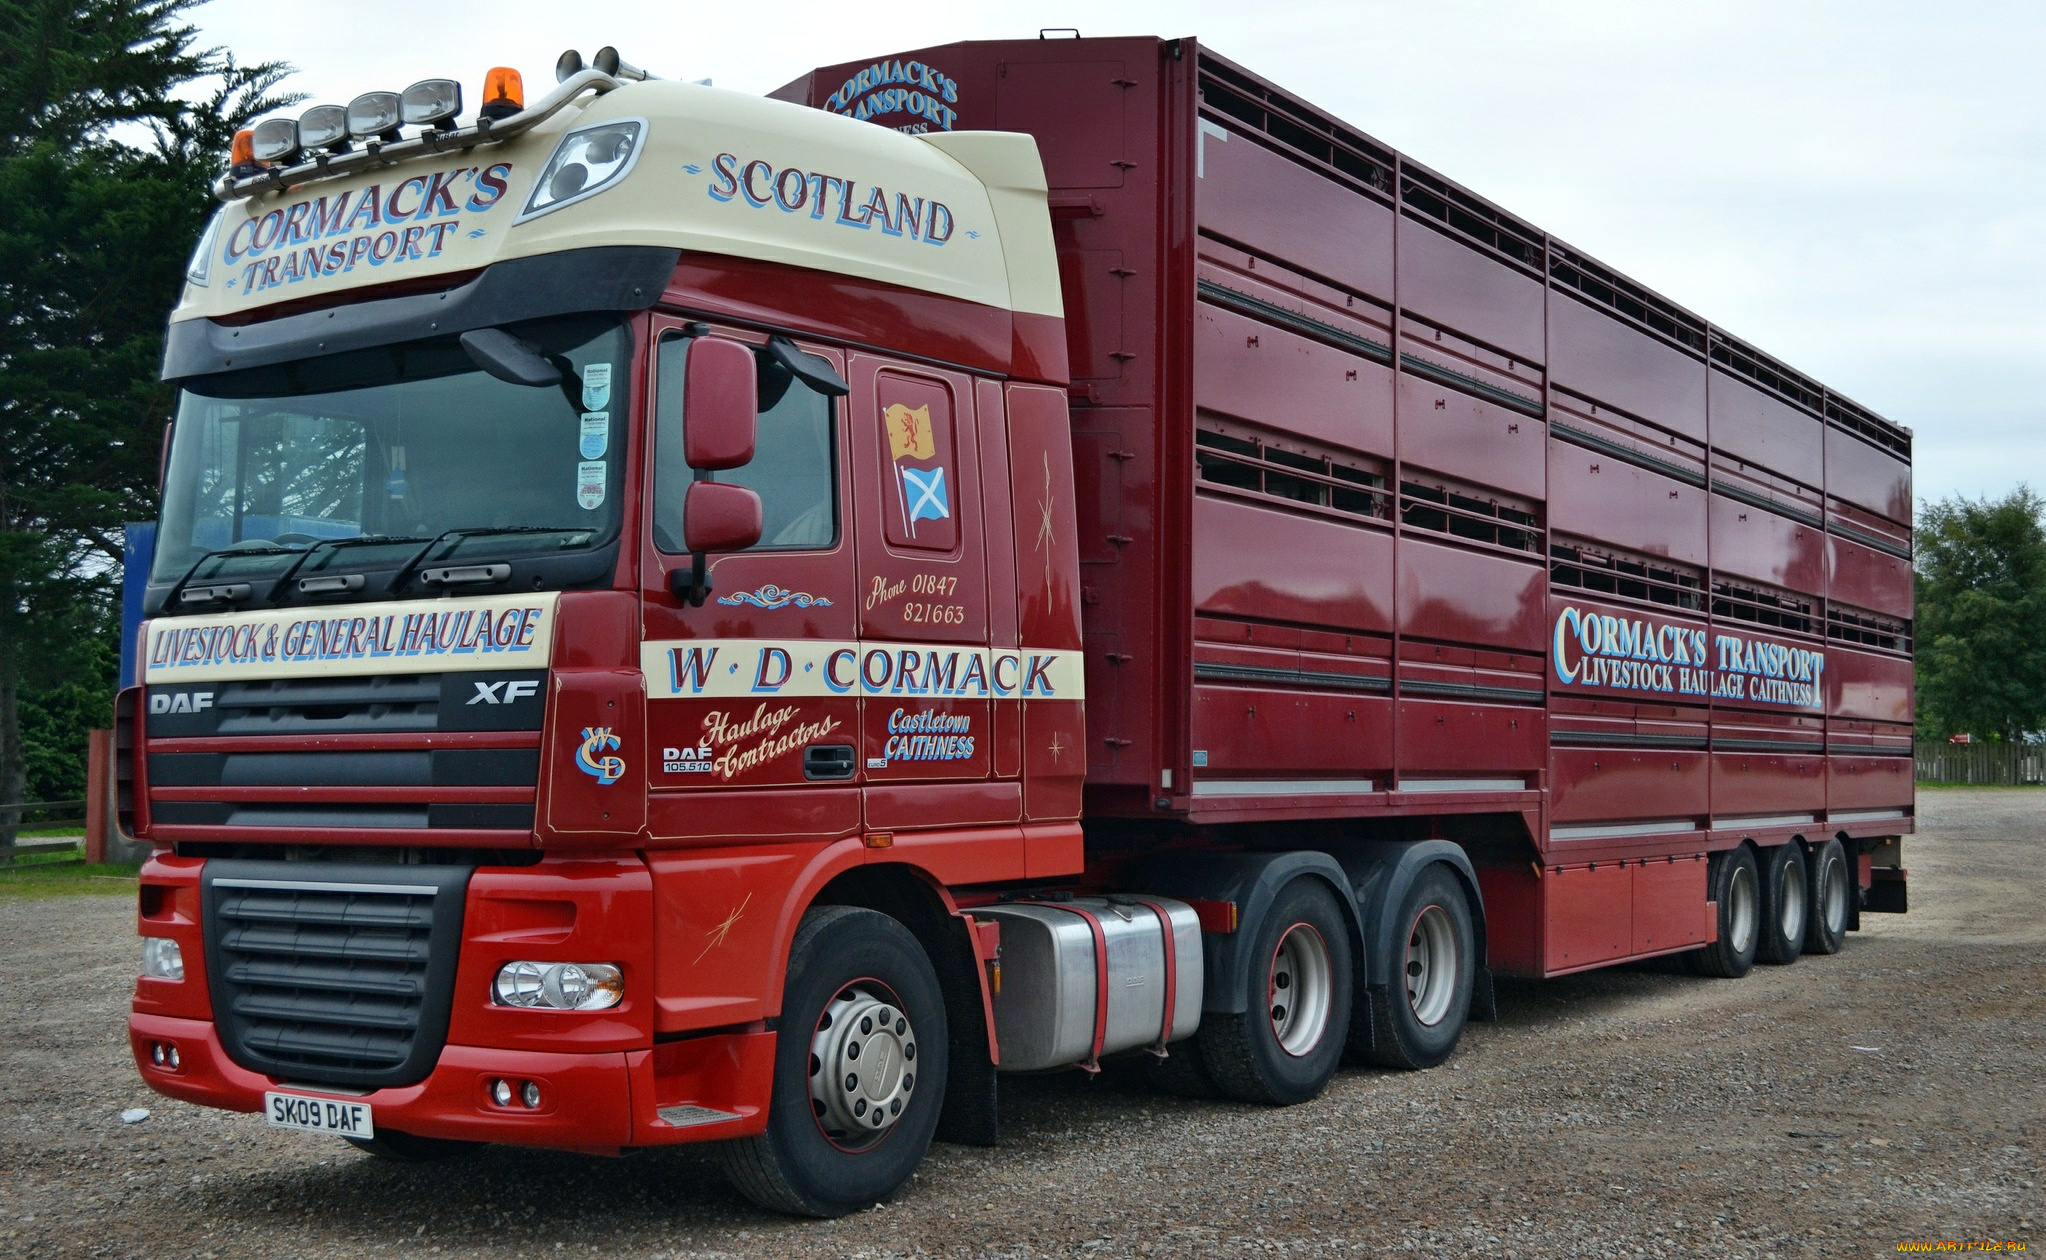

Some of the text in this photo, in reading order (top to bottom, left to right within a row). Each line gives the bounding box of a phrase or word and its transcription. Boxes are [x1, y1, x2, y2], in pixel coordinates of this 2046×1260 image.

[822, 59, 958, 113] CORMACK'S
[224, 162, 513, 265] CORMACK'S
[708, 153, 955, 246] SCOTLAND
[242, 221, 459, 295] TRANSPORT
[866, 573, 958, 611] Phone 01847
[903, 603, 965, 625] 821663
[149, 607, 543, 669] LIVESTOCK & GENERAL HAULAGE
[1553, 606, 1824, 707] CORMACK'S TRANSPORT
[466, 681, 539, 705] XF
[667, 647, 1060, 697] W D CORMACK
[1581, 656, 1812, 707] LIVESTOCK HAULAGE CAITHNESS
[151, 692, 213, 714] DAF
[699, 702, 801, 748] Haulage
[888, 708, 970, 737] Castletown
[663, 748, 712, 760] DAF
[664, 762, 712, 772] 105.510
[712, 714, 841, 778] Contractors
[884, 734, 975, 761] CAITHNESS
[273, 1097, 362, 1131] SK09 DAF
